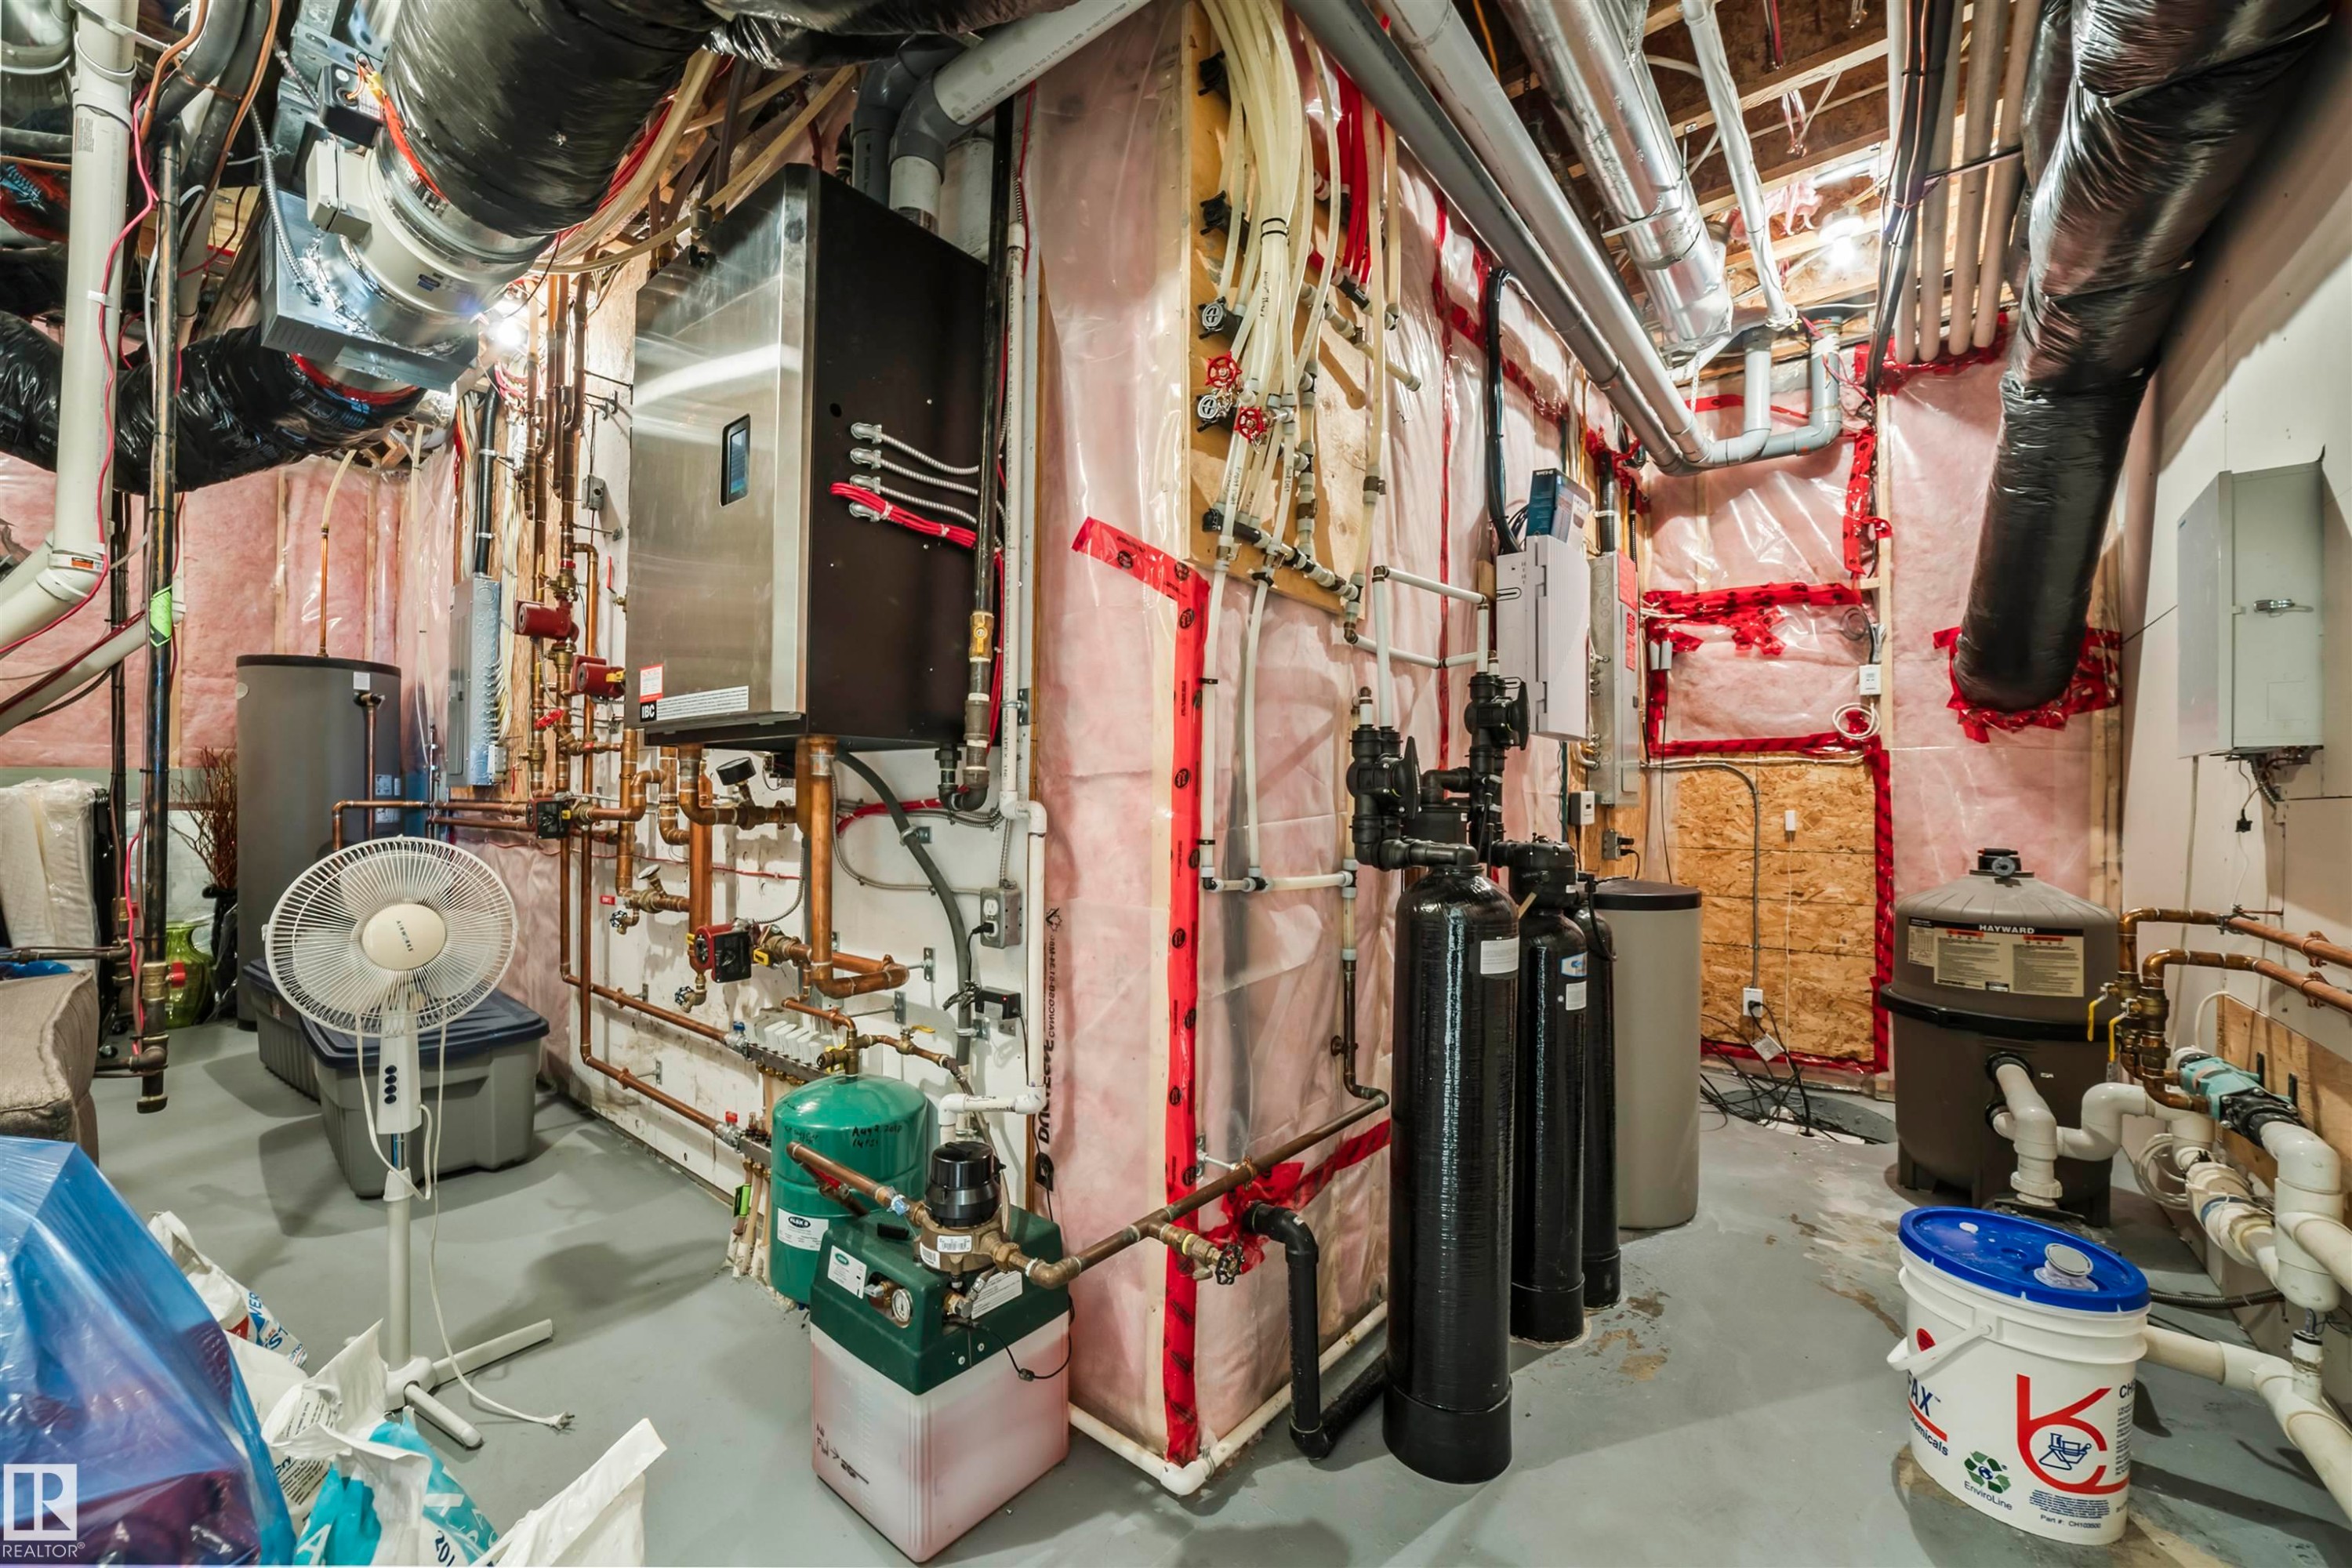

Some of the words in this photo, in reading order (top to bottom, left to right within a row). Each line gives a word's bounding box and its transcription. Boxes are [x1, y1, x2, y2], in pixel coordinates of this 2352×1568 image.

[641, 704, 655, 718] IBC
[1978, 924, 2035, 935] HAYWARD
[1964, 1480, 2013, 1511] EnviroLine
[2040, 1514, 2056, 1523] Part
